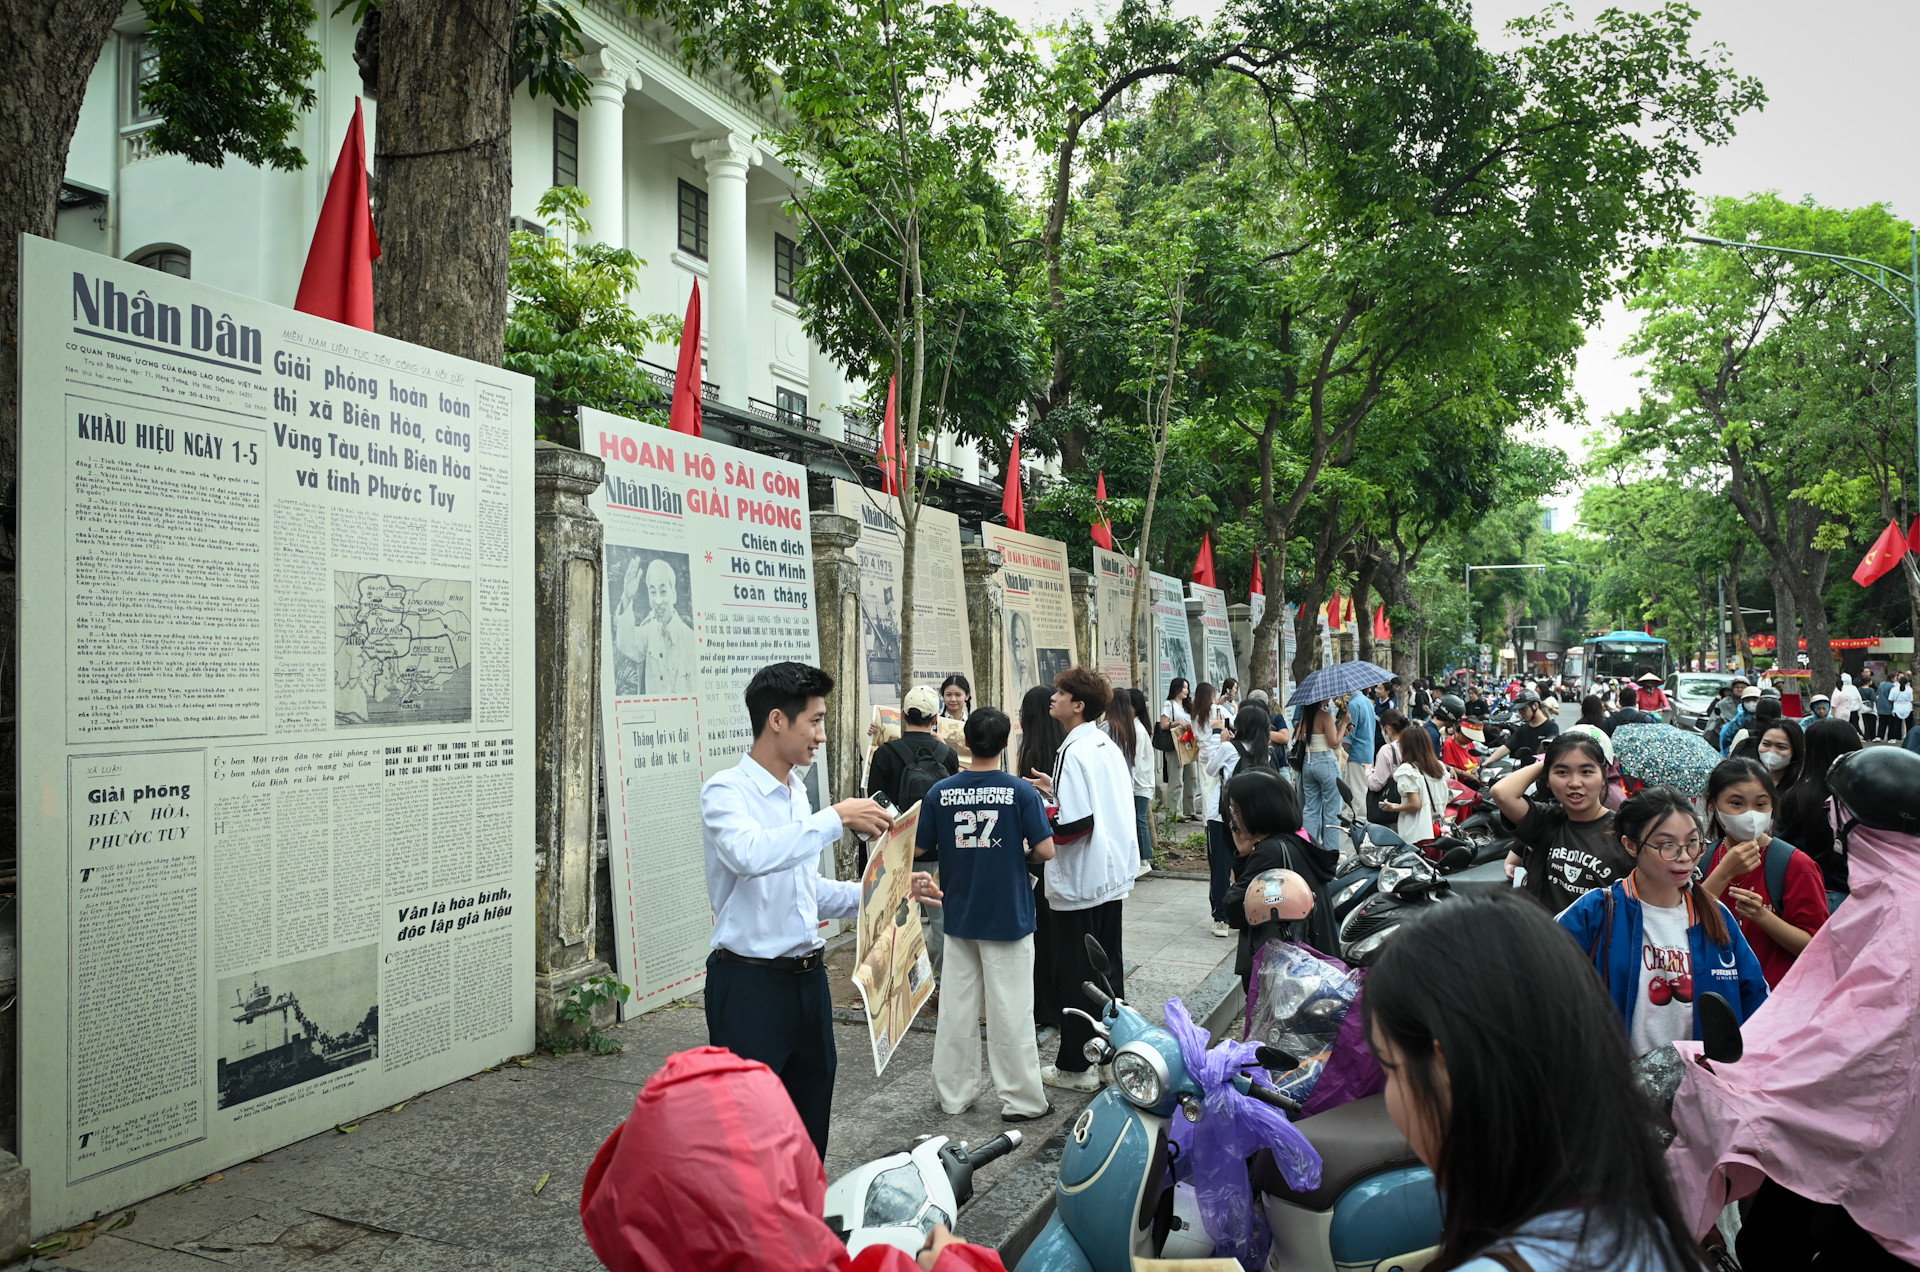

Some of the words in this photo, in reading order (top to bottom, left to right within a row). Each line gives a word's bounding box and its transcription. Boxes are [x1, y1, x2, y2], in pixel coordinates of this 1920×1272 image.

[73, 271, 181, 346] Nhân
[191, 303, 262, 365] Dân
[273, 350, 311, 382] Giải
[324, 365, 378, 400] phóng
[389, 379, 428, 409] hoàn
[439, 392, 470, 419] toàn
[273, 387, 298, 417] thị
[309, 398, 333, 421] xã
[342, 401, 380, 431] Biên
[390, 411, 426, 444] Hòa,
[136, 423, 175, 454] HIỆU
[184, 431, 223, 461] NGÀY
[232, 440, 258, 466] 1-5
[273, 422, 322, 459] Vũng
[327, 432, 364, 467] Tàu,
[367, 441, 398, 468] tỉnh
[404, 447, 438, 475] Biên
[442, 455, 471, 481] Hòa
[599, 431, 675, 473] HOAN
[684, 451, 716, 481] HÔ
[724, 460, 755, 490] SÀI
[762, 469, 801, 500] GÒN
[296, 468, 319, 489] và
[327, 468, 360, 495] tỉnh
[368, 474, 422, 504] Phước
[429, 484, 455, 514] Tuy
[604, 473, 650, 509] Nhân
[651, 483, 683, 515] Dân
[686, 486, 730, 519] GIẢI
[737, 498, 802, 531] PHÓNG
[861, 503, 883, 529] Nhân
[741, 532, 777, 553] Chiến
[780, 536, 805, 557] dịch
[731, 556, 751, 575] Hồ
[755, 562, 776, 577] Chí
[778, 563, 806, 580] Minh
[733, 583, 765, 601] toàn
[773, 586, 808, 609] thắng
[632, 730, 654, 749] Thắng
[656, 729, 667, 747] lợi
[678, 727, 689, 744] đại
[87, 767, 99, 775] XÃ
[101, 765, 122, 774] LUẬN
[213, 755, 227, 768] Ủy
[230, 758, 245, 766] ban
[252, 755, 268, 764] Mặt
[271, 755, 289, 764] trận
[293, 751, 309, 760] dân
[312, 751, 323, 760] tộc
[327, 749, 343, 760] giải
[346, 748, 368, 759] phóng
[634, 754, 646, 769] của
[651, 751, 664, 767] dân
[667, 751, 678, 767] tộc
[683, 749, 691, 763] ta
[213, 768, 227, 781] Ủy
[230, 770, 245, 778] ban
[250, 767, 271, 776] nhân
[274, 765, 289, 774] dân
[294, 763, 312, 772] cách
[317, 762, 337, 771] mạng
[88, 786, 125, 804] Giải
[940, 787, 976, 798] WORLD
[976, 787, 1015, 796] SERIES
[940, 793, 1014, 806] CHAMPIONS
[87, 809, 133, 828] BIÊN
[150, 806, 190, 821] HÒA,
[87, 829, 153, 851] PHƯỚC
[157, 826, 190, 843] TUY
[1551, 862, 1564, 872] PHYS
[398, 905, 429, 923] Vẫn
[431, 901, 446, 915] là
[449, 896, 475, 911] hòa
[477, 887, 512, 905] bình,
[397, 924, 426, 942] độc
[430, 918, 454, 934] lập
[456, 910, 480, 930] giả
[483, 905, 513, 922] hiệu
[1642, 944, 1692, 975] CHERRI
